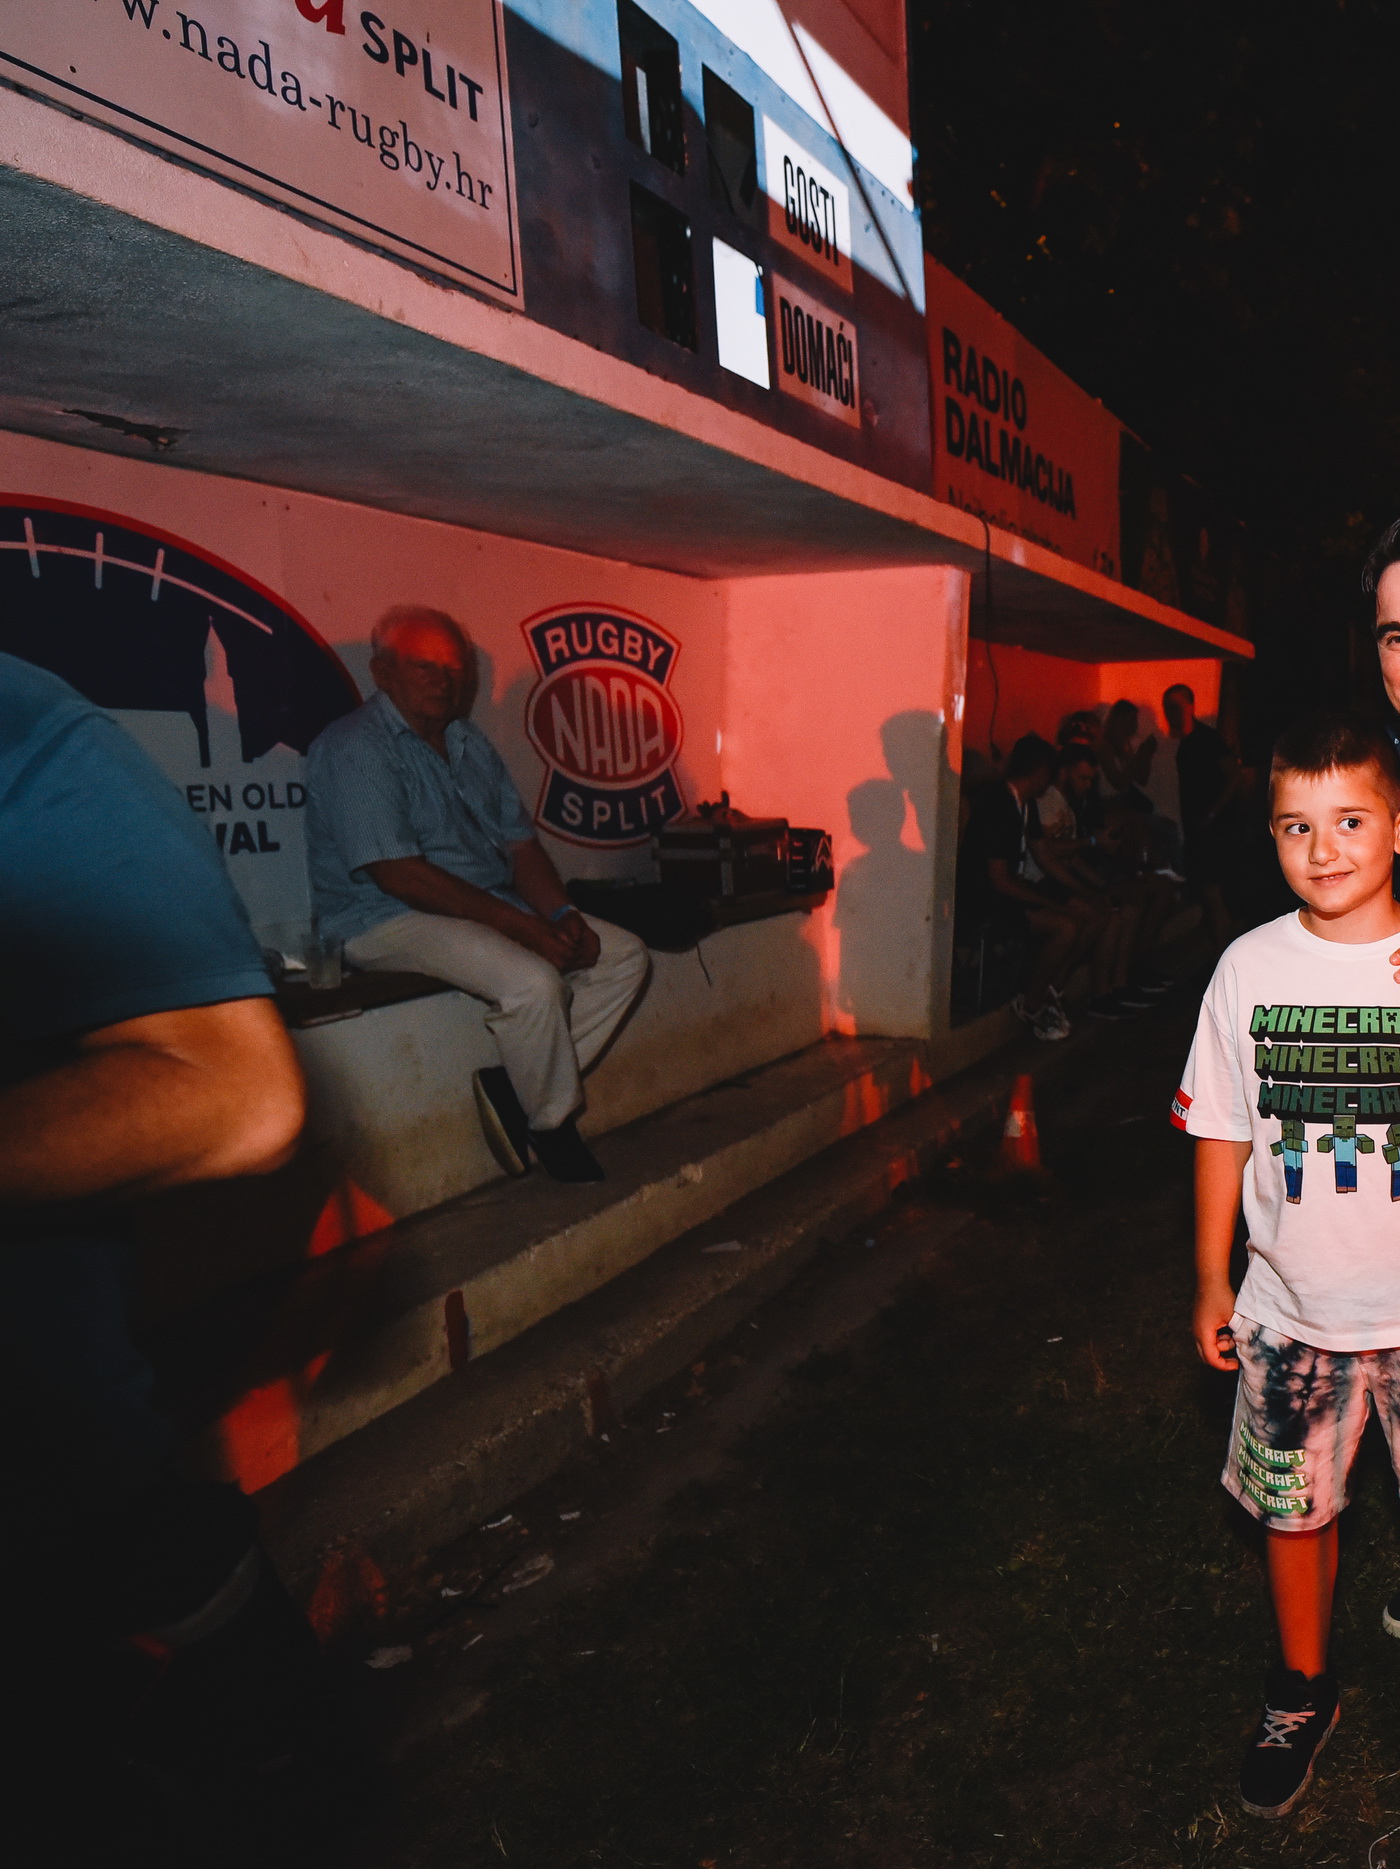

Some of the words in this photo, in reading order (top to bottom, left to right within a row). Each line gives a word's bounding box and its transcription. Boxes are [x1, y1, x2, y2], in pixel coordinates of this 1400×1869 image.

[94, 0, 493, 209] w.nada-rugby.hr
[359, 10, 483, 122] SPLIT
[783, 154, 839, 267] GOSTI
[778, 294, 857, 411] DOMAĆI
[942, 326, 1027, 431] RADIO
[945, 396, 1077, 520] DALMACIJA
[544, 620, 668, 672] RUGBY
[551, 674, 665, 777] NADA
[242, 782, 308, 811] OLD
[561, 784, 667, 832] SPLIT
[1238, 1445, 1306, 1489] MINECRAFT
[1239, 1470, 1308, 1512] MINECRAFT
[1240, 1421, 1306, 1466] MINECRAFT
